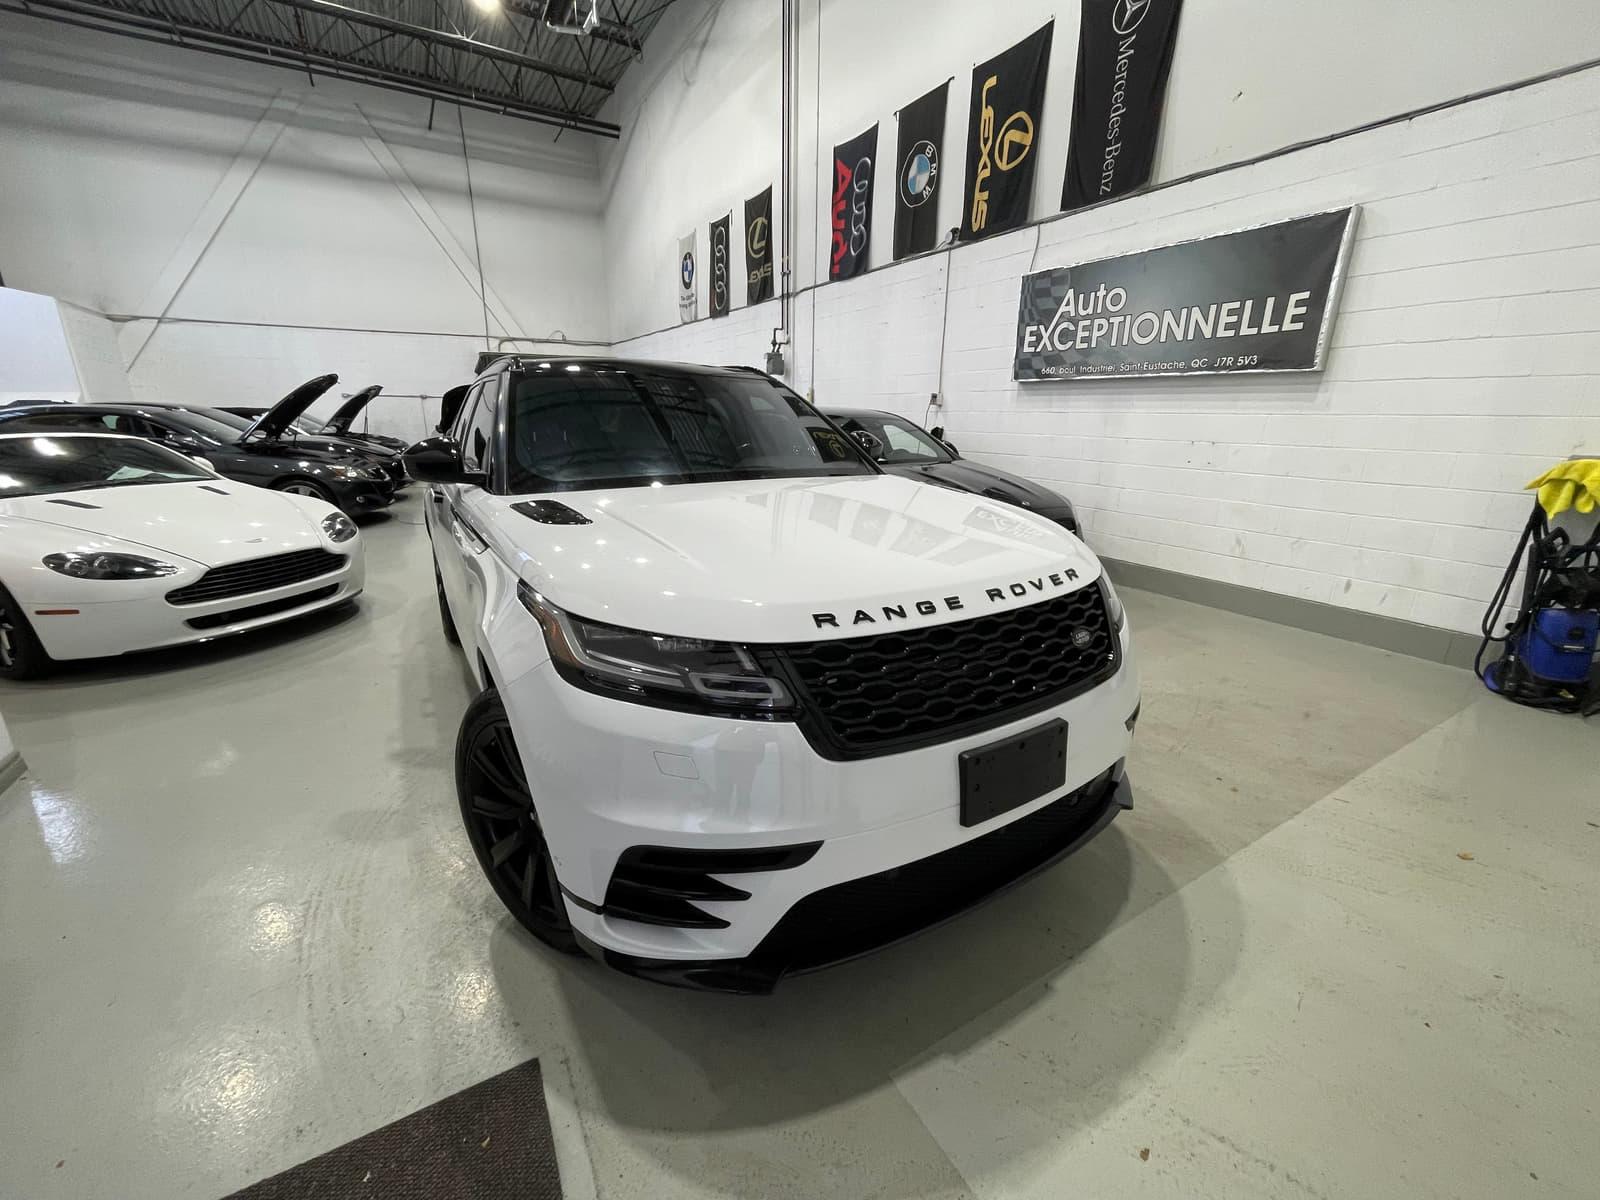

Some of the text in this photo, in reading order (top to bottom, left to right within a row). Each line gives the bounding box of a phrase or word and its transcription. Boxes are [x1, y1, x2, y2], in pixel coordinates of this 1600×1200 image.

[1099, 33, 1137, 195] Mercedes-Benz
[971, 75, 998, 232] LEXUS
[1023, 291, 1311, 353] EXCEPTIONNELLE
[1056, 283, 1127, 318] Auto
[1191, 358, 1208, 368] QC
[1214, 356, 1234, 367] J7R
[1237, 355, 1258, 366] 5V3
[812, 568, 1080, 628] RANGE ROVER
